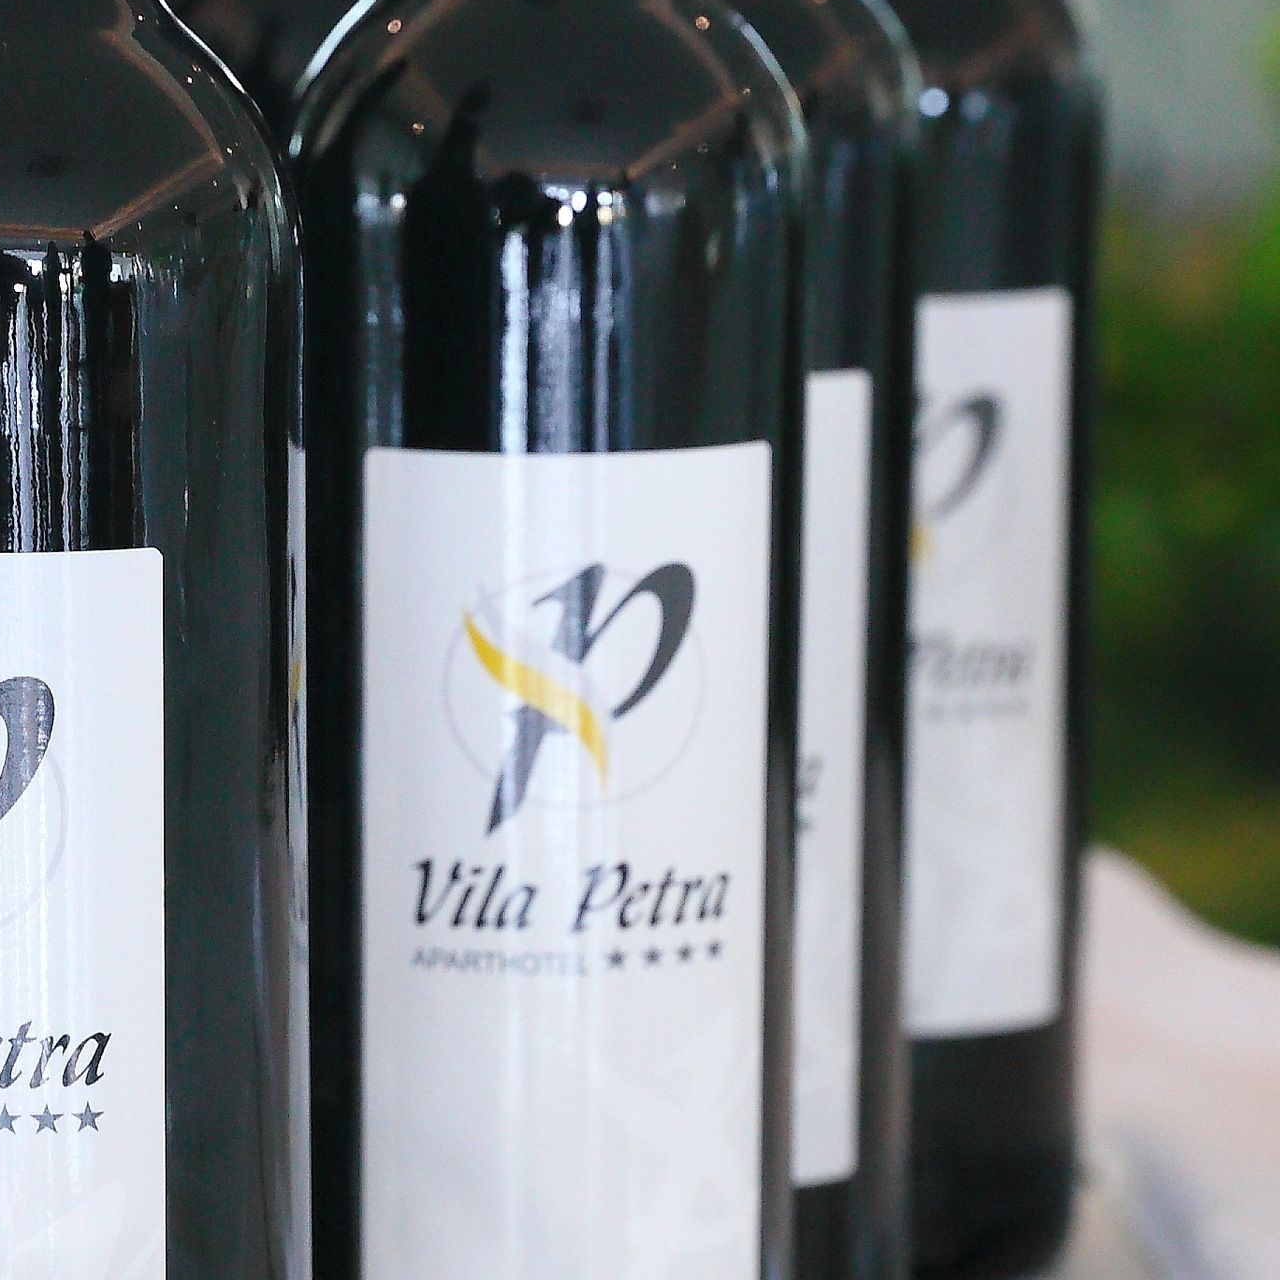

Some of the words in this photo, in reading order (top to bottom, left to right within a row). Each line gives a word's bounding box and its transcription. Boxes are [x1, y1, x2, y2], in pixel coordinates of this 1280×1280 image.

[410, 856, 538, 932] Vila
[570, 860, 732, 933] Petra
[411, 945, 589, 978] APARTHOTEL
